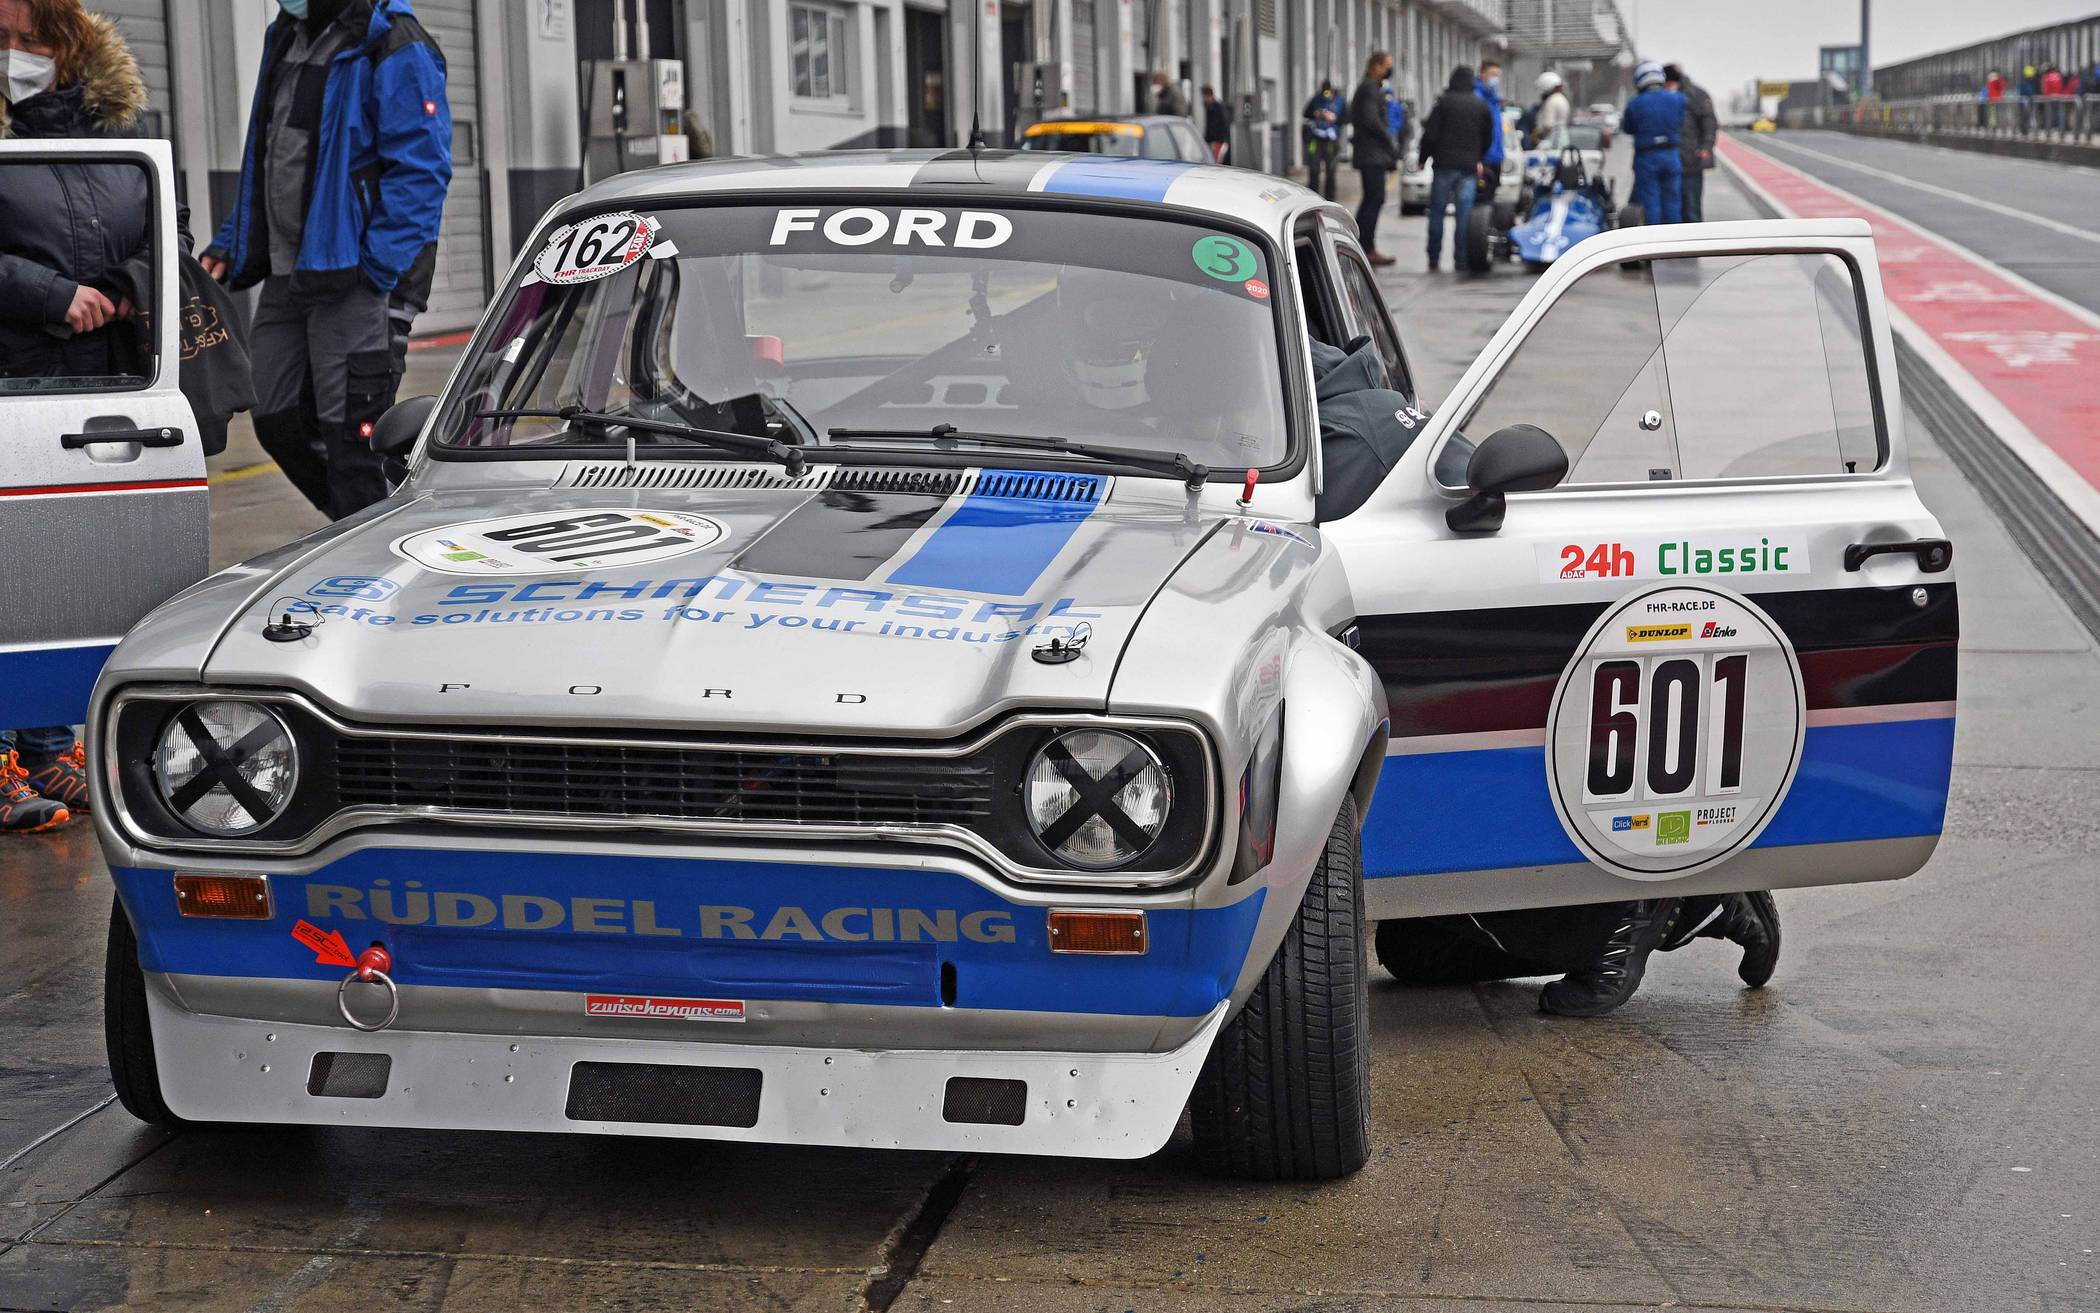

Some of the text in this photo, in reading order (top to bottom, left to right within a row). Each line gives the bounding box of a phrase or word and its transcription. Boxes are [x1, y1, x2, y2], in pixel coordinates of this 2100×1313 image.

[553, 219, 638, 272] 162
[769, 207, 1013, 249] FORD
[554, 269, 577, 279] FHR
[578, 265, 610, 275] TRACKDAY
[1208, 240, 1240, 276] 3
[1246, 283, 1268, 295] 2020
[482, 513, 695, 562] 601
[1560, 538, 1789, 578] 24h Classic
[1561, 569, 1585, 579] ADAC
[438, 575, 1102, 622] SCHMERSAL
[1646, 600, 1716, 613] FHR-RACE.DE
[287, 601, 1090, 644] Safe solutions for your industry
[1638, 628, 1688, 638] DUNLOP
[1712, 625, 1737, 638] Enke
[1587, 655, 1748, 796] 601
[1697, 806, 1737, 820] PROJECT
[305, 879, 1016, 944] RÜDDEL RACING
[590, 998, 742, 1019] zwischengas.com
